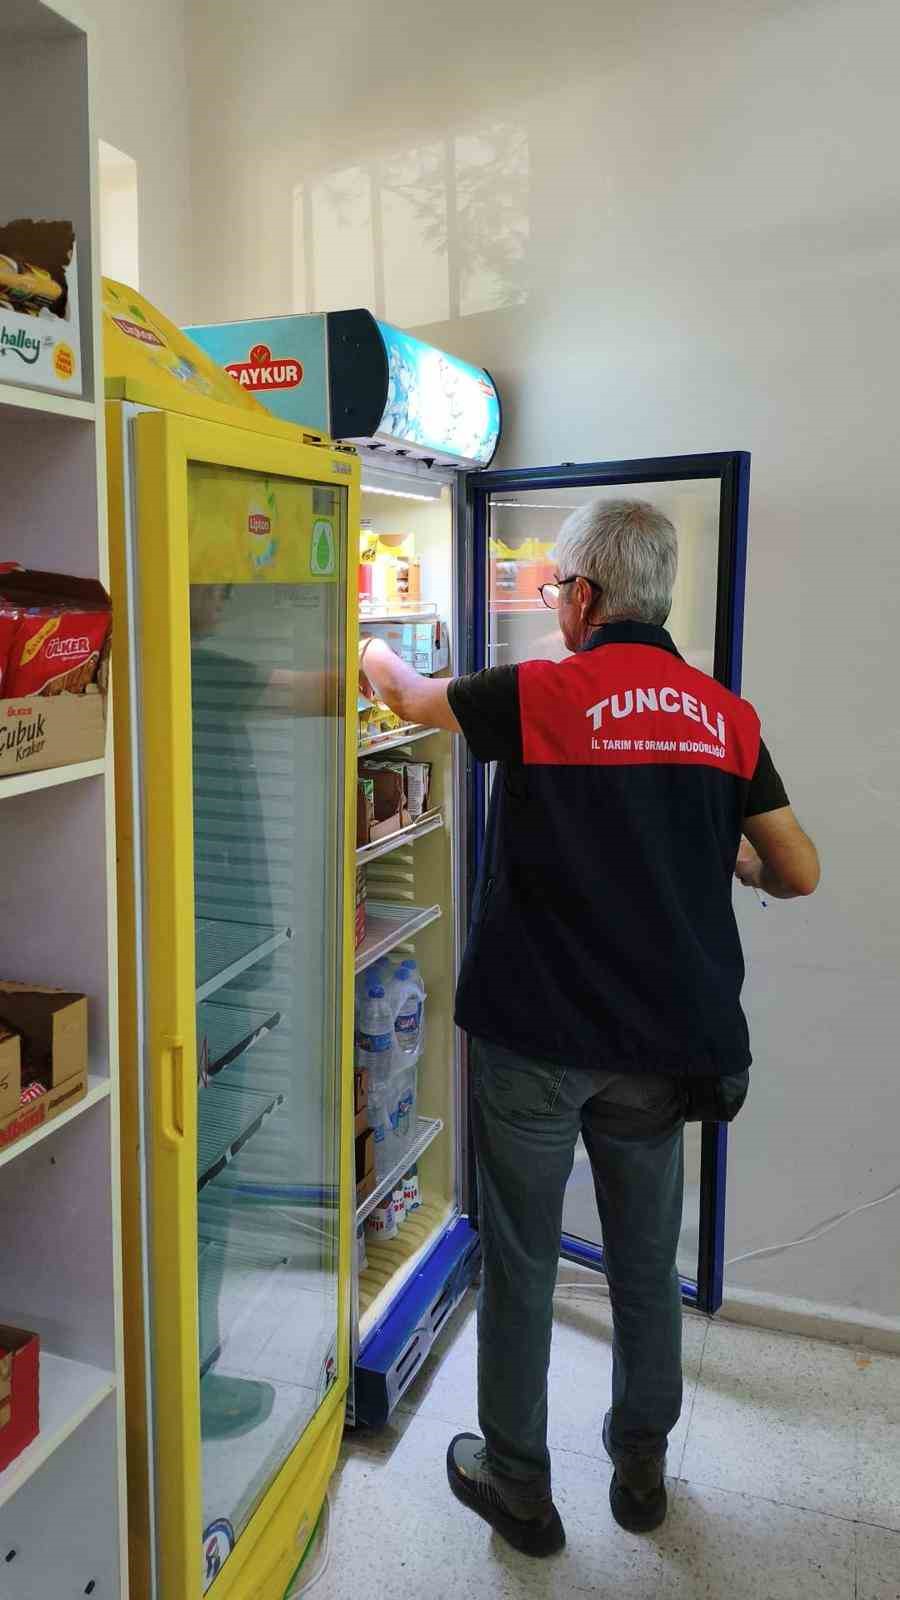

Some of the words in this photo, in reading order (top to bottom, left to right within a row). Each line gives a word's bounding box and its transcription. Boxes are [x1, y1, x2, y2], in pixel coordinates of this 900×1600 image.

[1, 326, 40, 364] halley
[585, 686, 726, 746] TUNCELİ
[591, 736, 601, 750] İL
[602, 739, 632, 751] TARIM
[634, 739, 645, 751] VE
[645, 740, 677, 752] ORMAN
